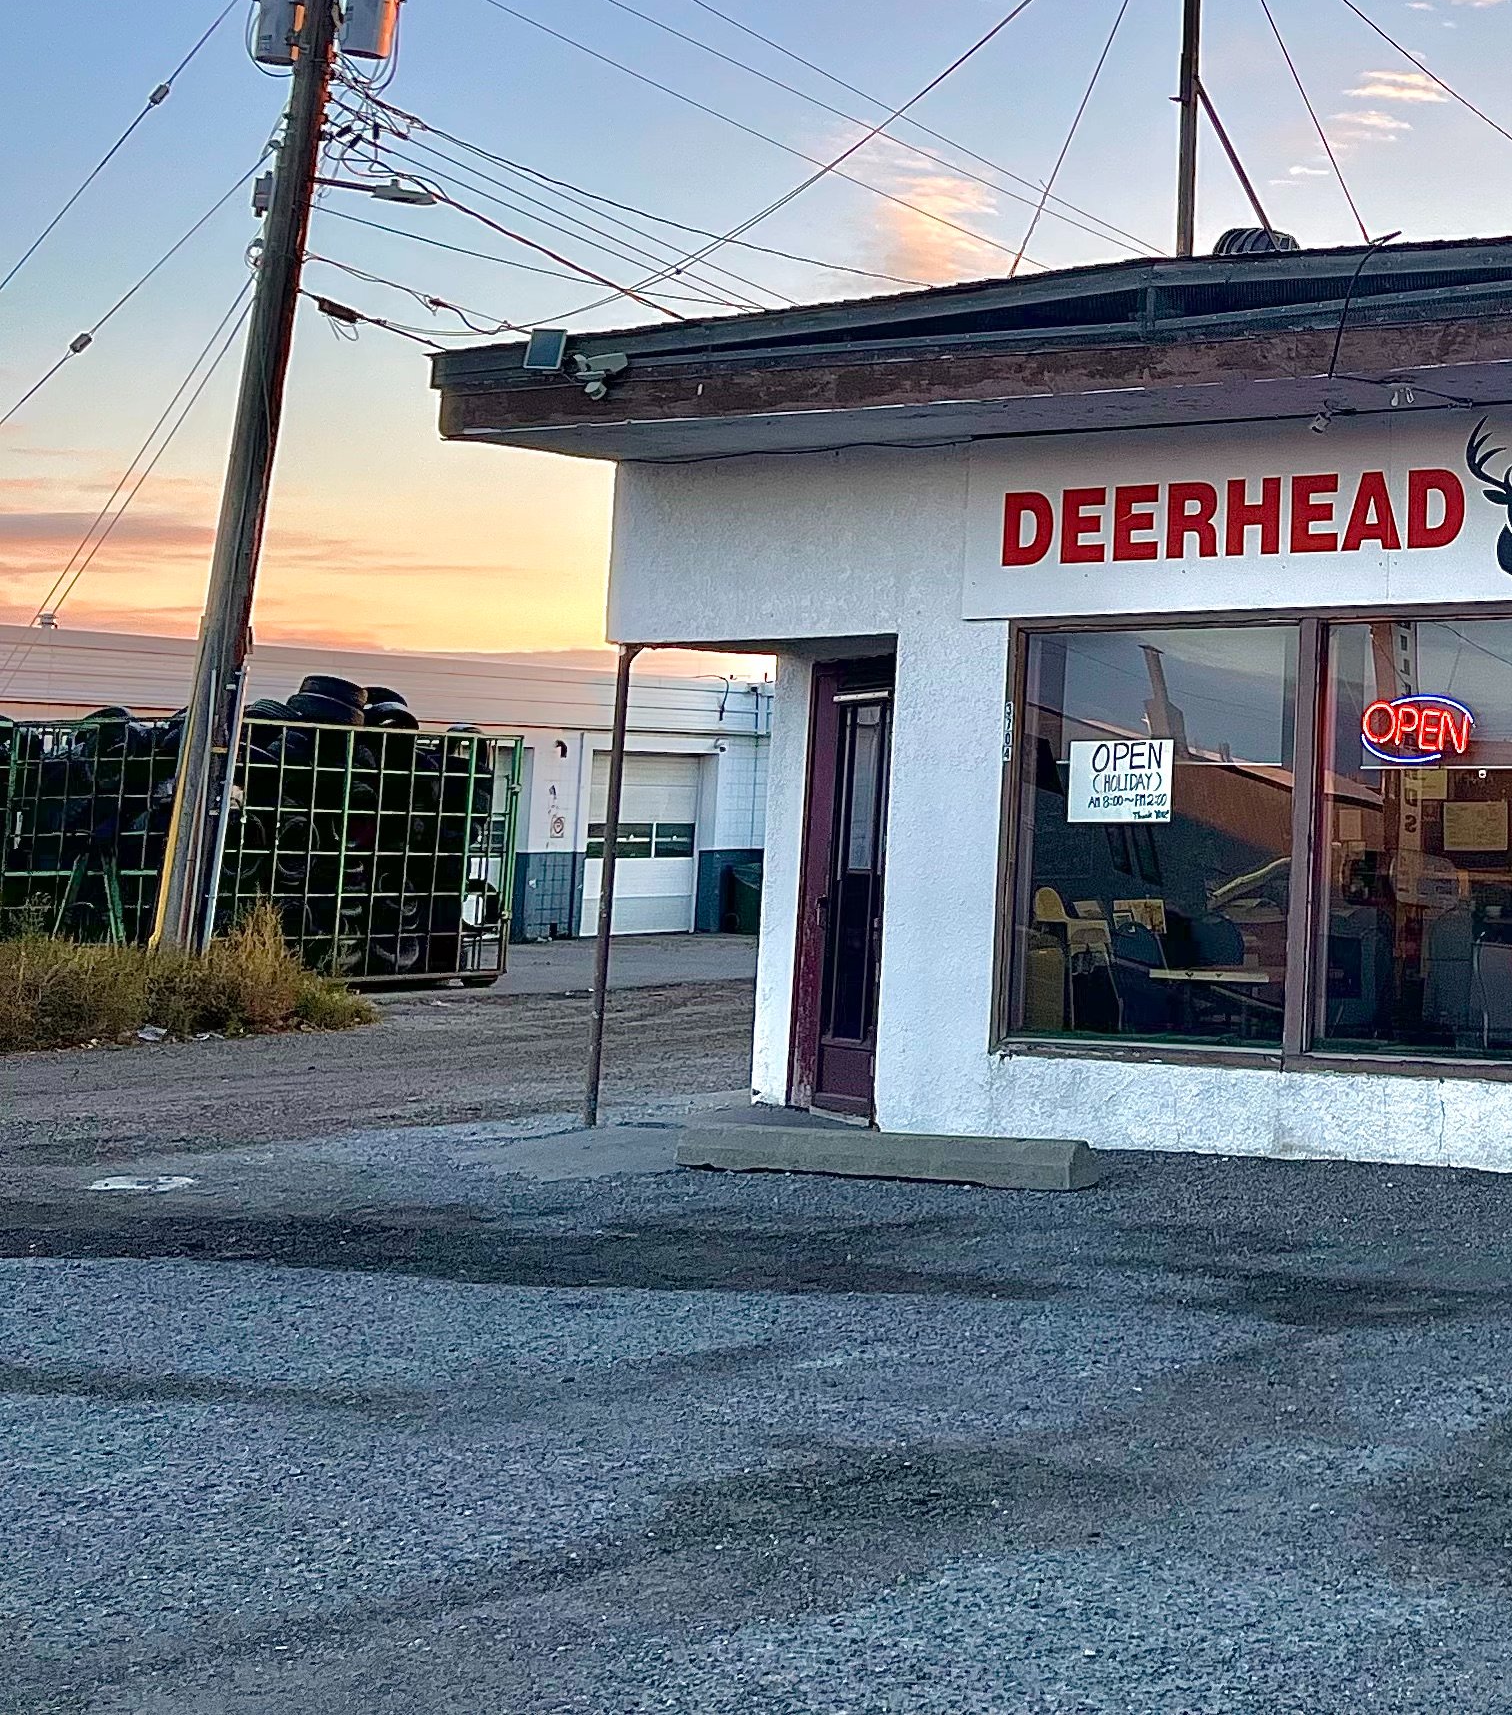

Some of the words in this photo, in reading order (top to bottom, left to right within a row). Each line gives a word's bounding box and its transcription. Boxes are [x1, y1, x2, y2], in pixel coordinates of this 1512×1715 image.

[1001, 467, 1466, 567] DEERHEAD
[1004, 703, 1012, 761] 3704
[1362, 698, 1471, 754] OPEN
[1091, 742, 1163, 773] OPEN
